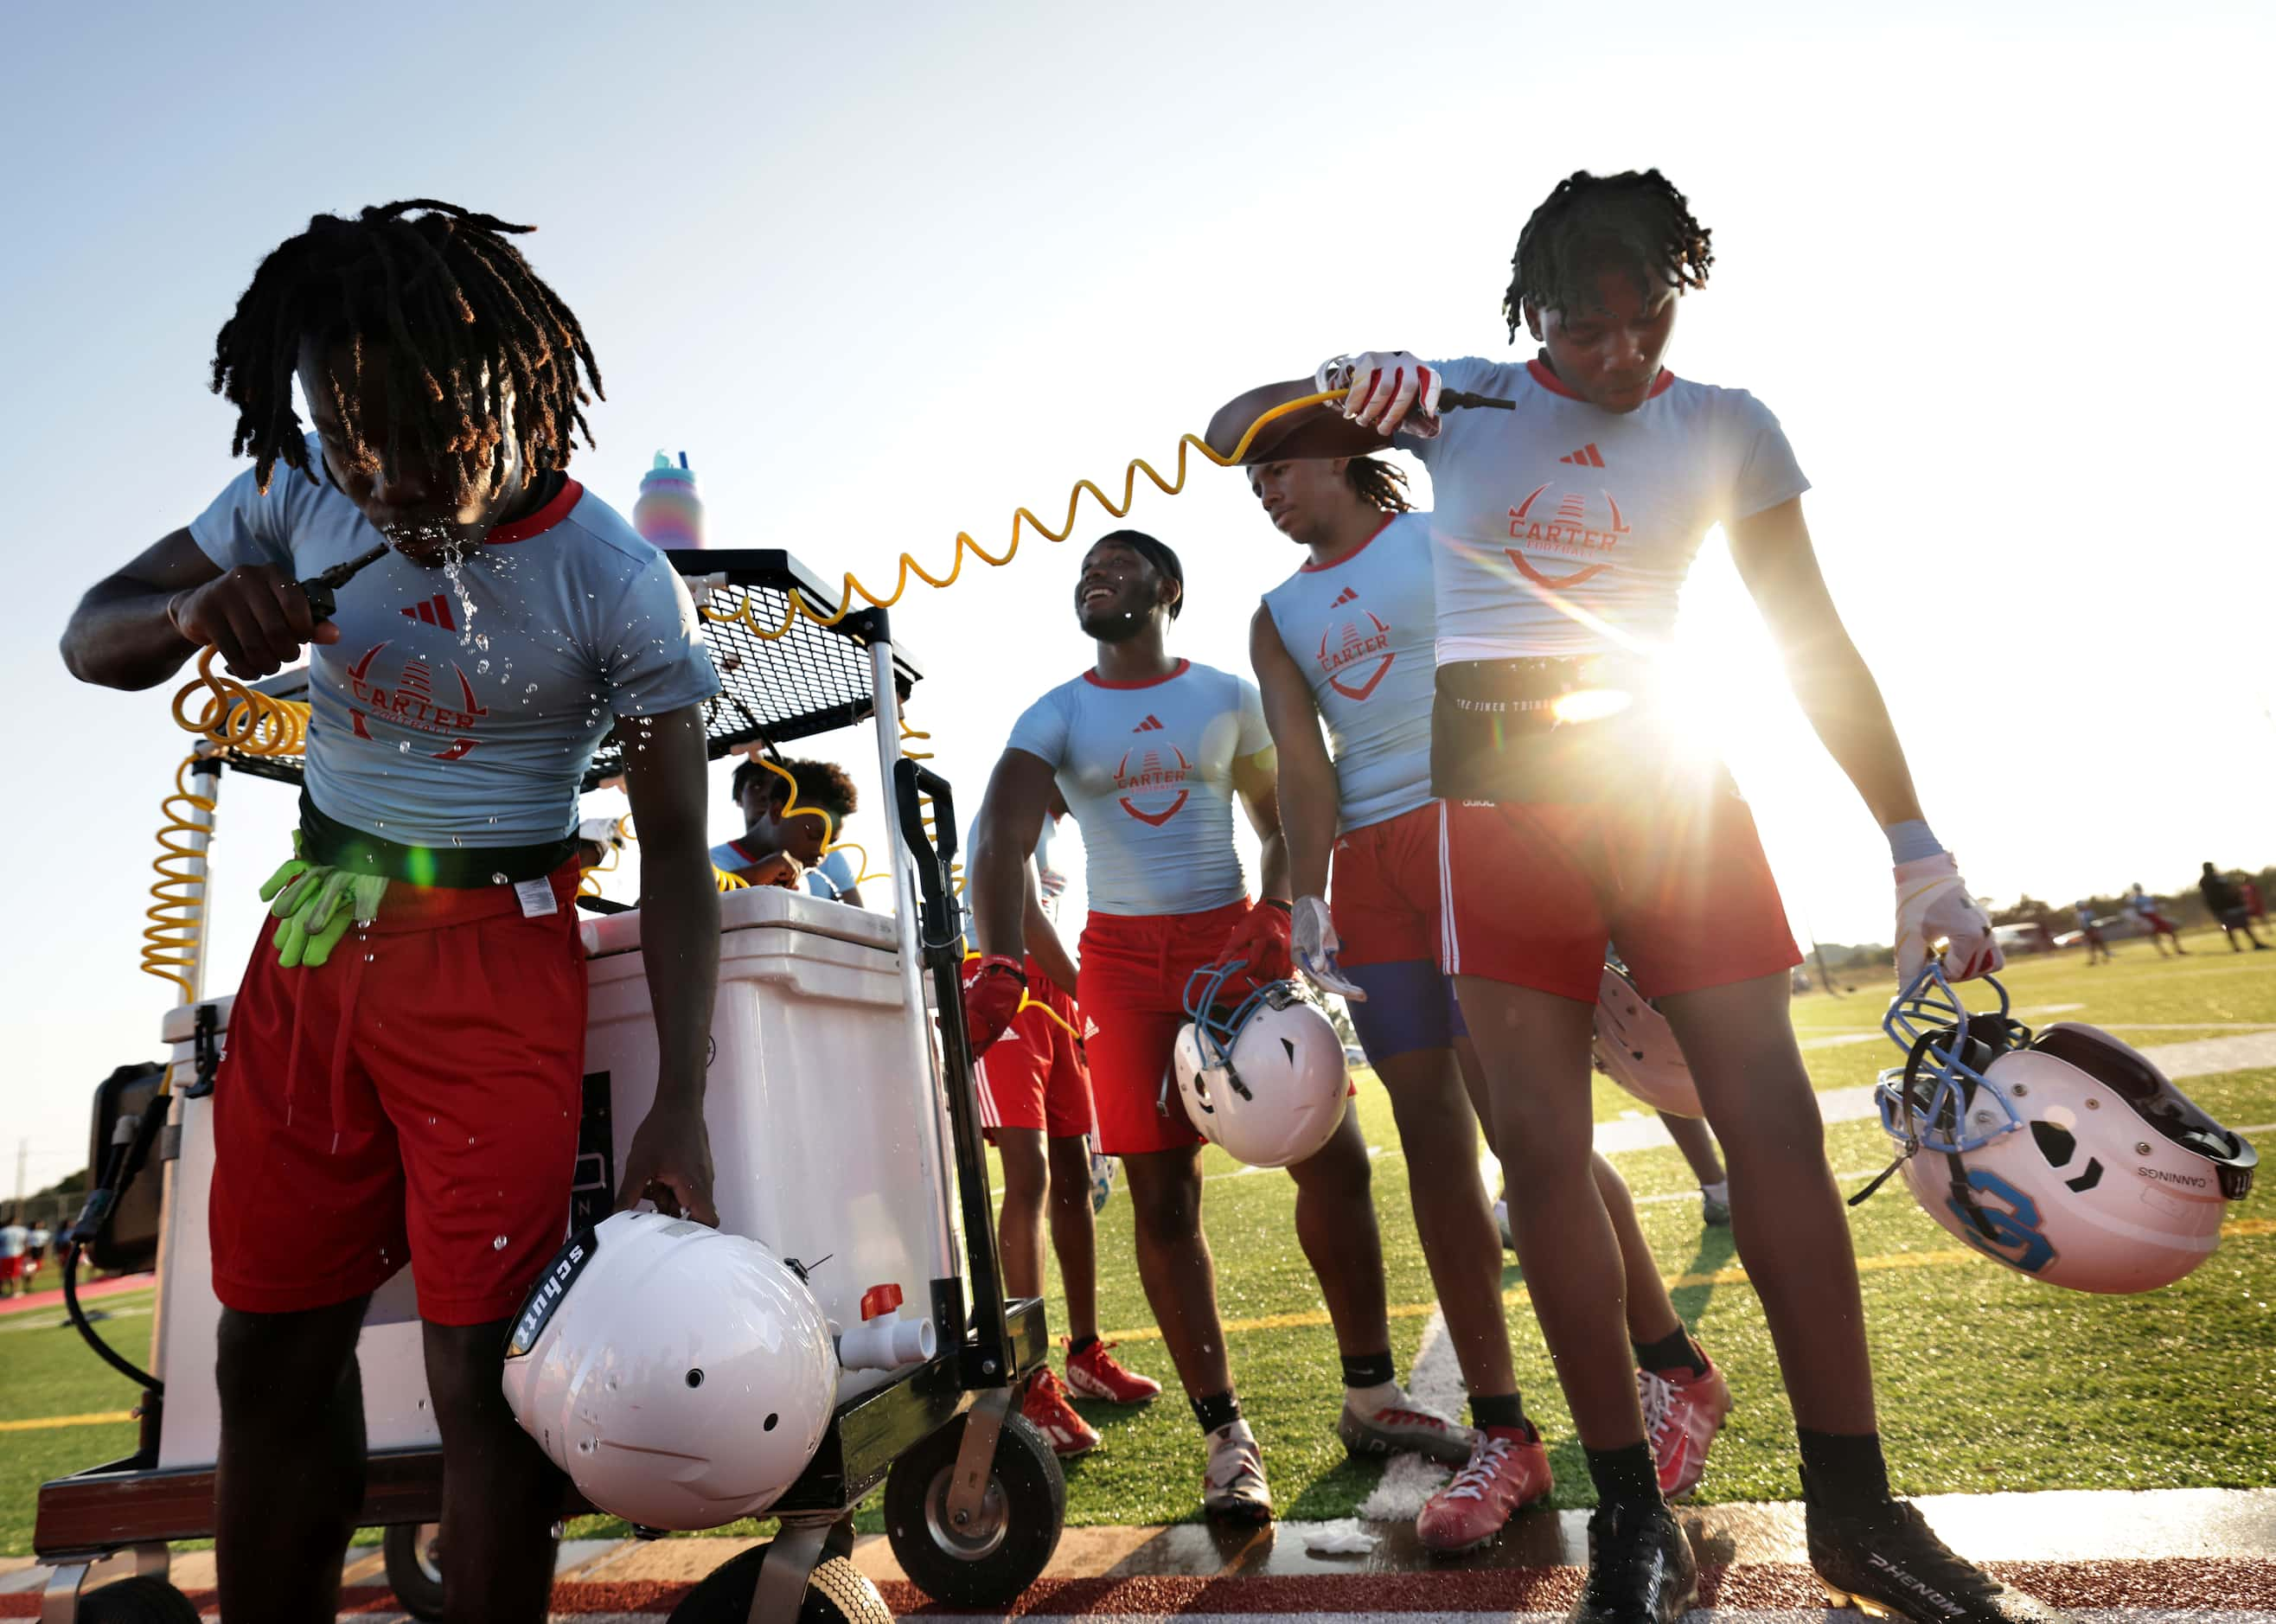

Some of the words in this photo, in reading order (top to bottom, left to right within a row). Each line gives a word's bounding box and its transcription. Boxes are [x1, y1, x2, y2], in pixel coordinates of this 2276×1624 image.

[1509, 519, 1618, 551] CARTER
[1320, 634, 1390, 673] CARTER
[352, 680, 475, 729] CARTER
[1117, 770, 1186, 789] CARTER
[2137, 1167, 2207, 1188] CANNINGS
[517, 1244, 585, 1346] schutt
[1868, 1551, 1968, 1616] PHENOM
